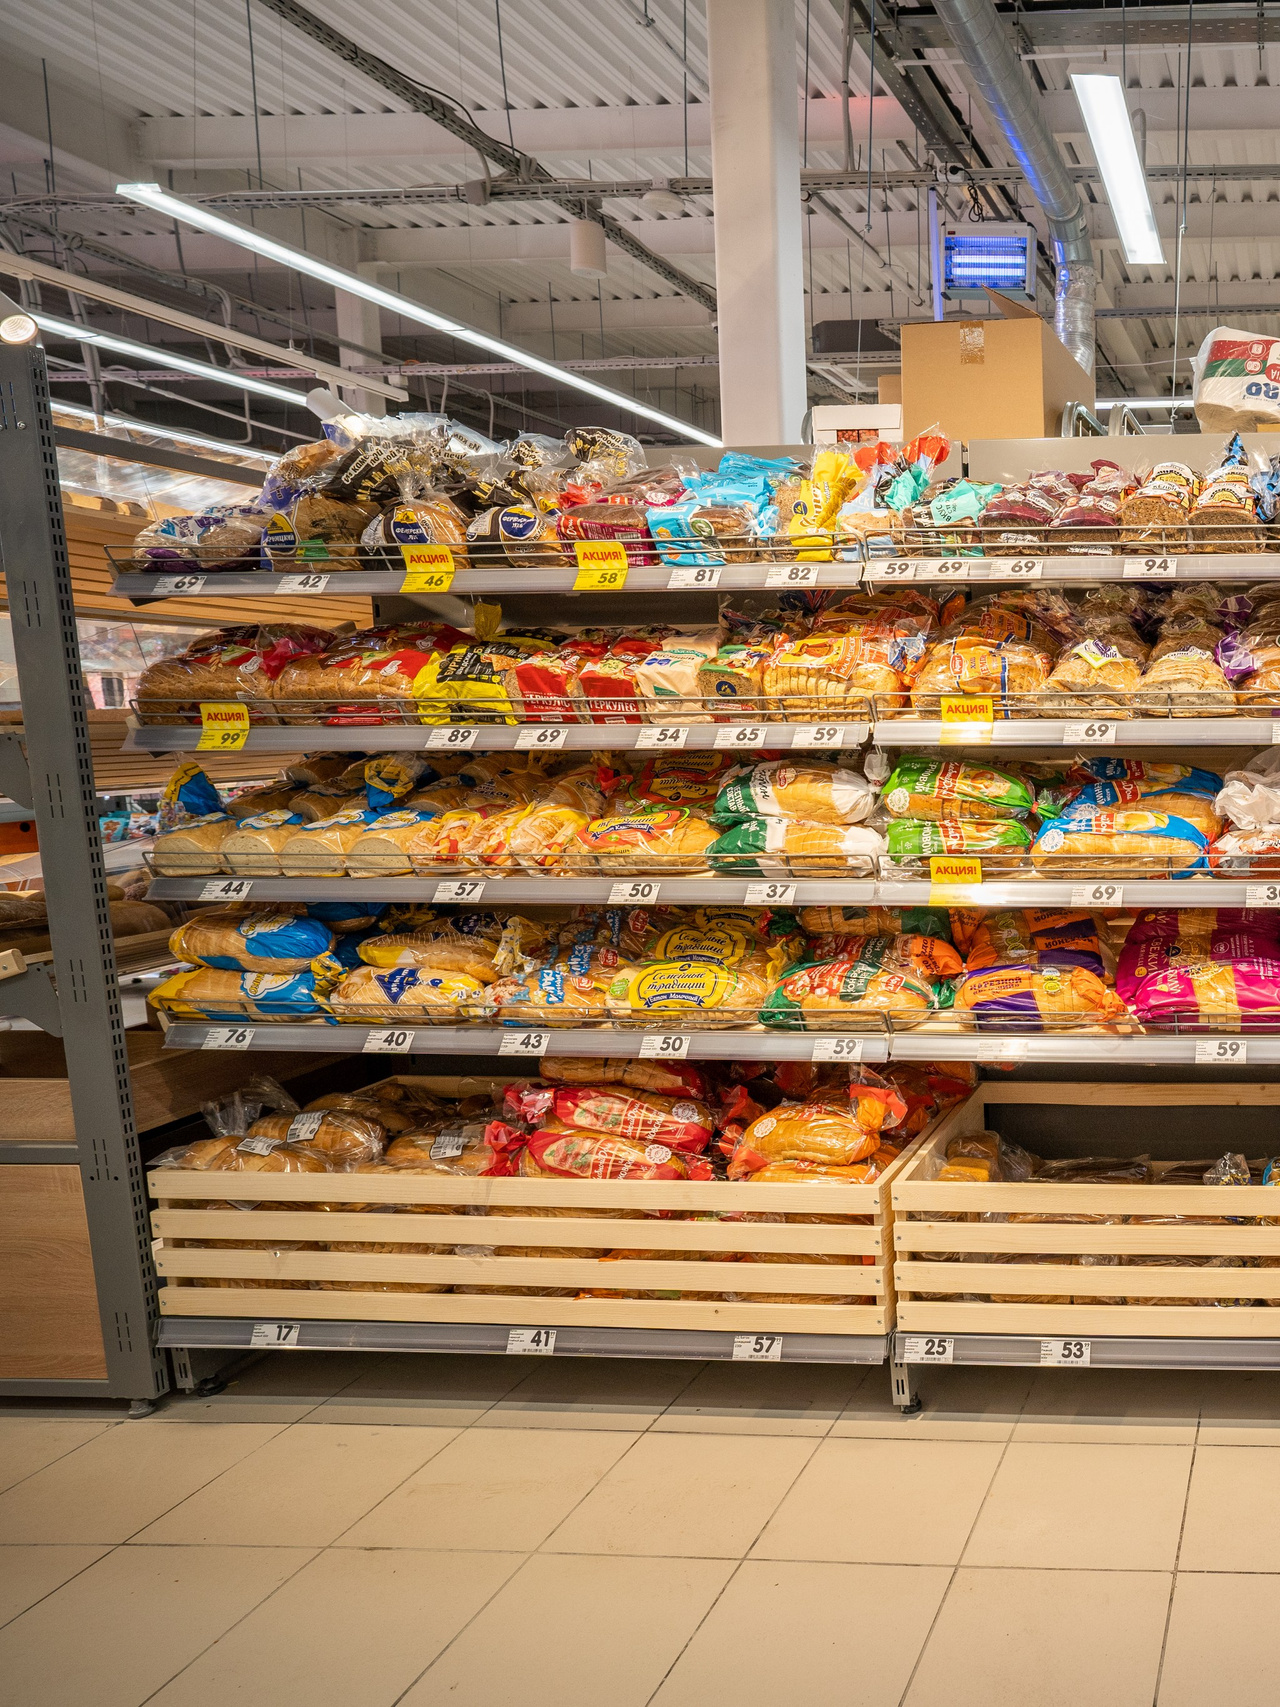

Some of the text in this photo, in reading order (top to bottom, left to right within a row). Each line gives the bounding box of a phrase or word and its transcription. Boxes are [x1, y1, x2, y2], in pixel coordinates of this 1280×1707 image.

[409, 553, 449, 565] АКЦИЯ!
[582, 550, 622, 561] АКЦИЯ!
[884, 562, 909, 576] 59
[937, 562, 962, 574] 69
[1010, 560, 1036, 573] 69
[1144, 558, 1170, 572] 94
[424, 575, 445, 587] 46
[597, 573, 618, 584] 58
[694, 569, 714, 582] 81
[787, 567, 811, 581] 82
[174, 576, 198, 589] 69
[298, 575, 321, 589] 42
[589, 699, 636, 713] ГЕРКУЛЕС
[946, 703, 989, 714] АКЦИЯ!
[206, 711, 245, 722] АКЦИЯ!
[447, 729, 472, 743] 89
[536, 729, 562, 742] 69
[656, 728, 681, 742] 54
[735, 728, 760, 741] 65
[813, 727, 837, 741] 59
[1084, 723, 1110, 738] 69
[220, 732, 241, 745] 99
[726, 785, 737, 811] СОСТАВ
[935, 865, 977, 876] АКЦИЯ!
[219, 881, 245, 895] 44
[454, 882, 479, 897] 57
[628, 884, 653, 898] 50
[765, 884, 790, 899] 37
[1091, 885, 1117, 901] 69
[652, 971, 706, 981] Семейные
[969, 975, 1023, 990] НАРЕЗНОЙ
[648, 979, 706, 992] традиции
[649, 993, 699, 1003] Батон Молочный
[224, 1029, 247, 1044] 76
[382, 1031, 407, 1046] 40
[519, 1034, 543, 1049] 43
[659, 1036, 684, 1052] 50
[833, 1039, 857, 1055] 59
[1216, 1042, 1241, 1057] 59
[276, 1325, 294, 1342] 17
[530, 1330, 551, 1347] 41
[753, 1337, 776, 1353] 57
[924, 1339, 947, 1356] 25
[1060, 1341, 1084, 1359] 53
